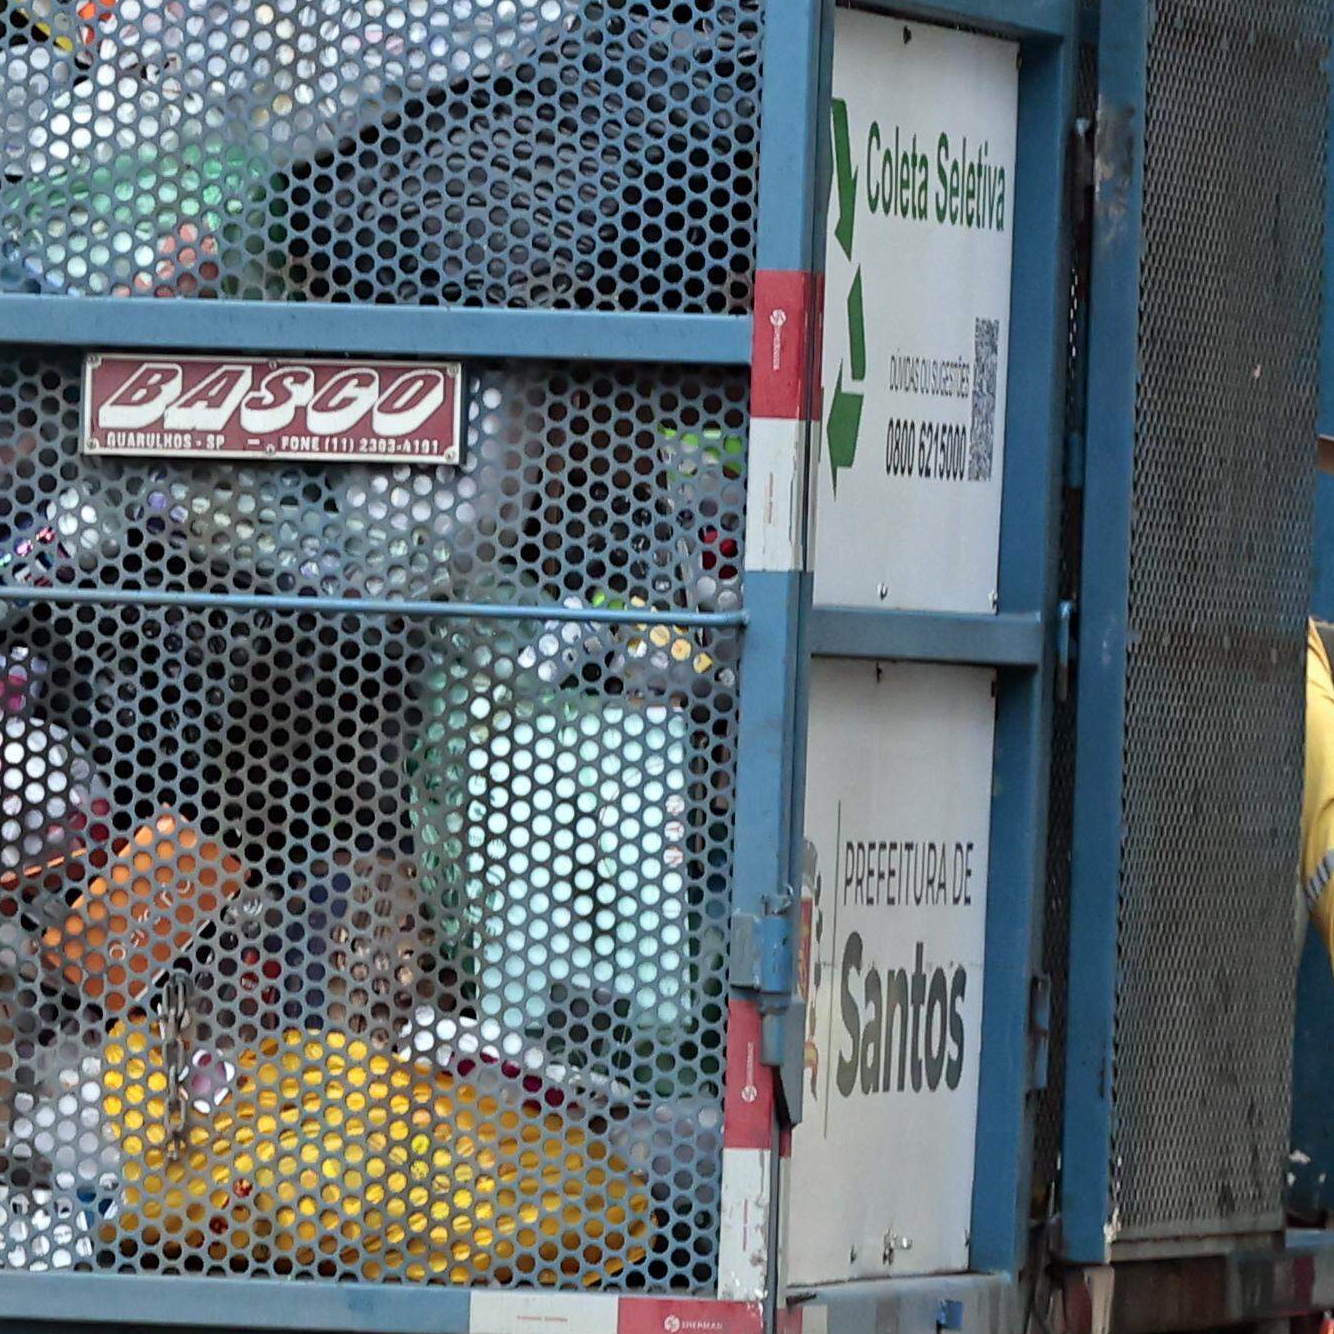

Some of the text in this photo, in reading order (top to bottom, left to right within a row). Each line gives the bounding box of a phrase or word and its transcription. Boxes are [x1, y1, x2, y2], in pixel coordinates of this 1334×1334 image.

[866, 120, 1006, 232] Coleta Seletiva
[98, 363, 444, 436] BASCO
[106, 431, 192, 449] GUARULHOS
[206, 434, 225, 449] SP
[281, 436, 320, 451] FONE
[325, 436, 354, 453] (11)
[886, 417, 967, 481] 0800 6215000
[844, 840, 974, 907] PREFEITURA DE
[836, 931, 967, 1098] Santos
